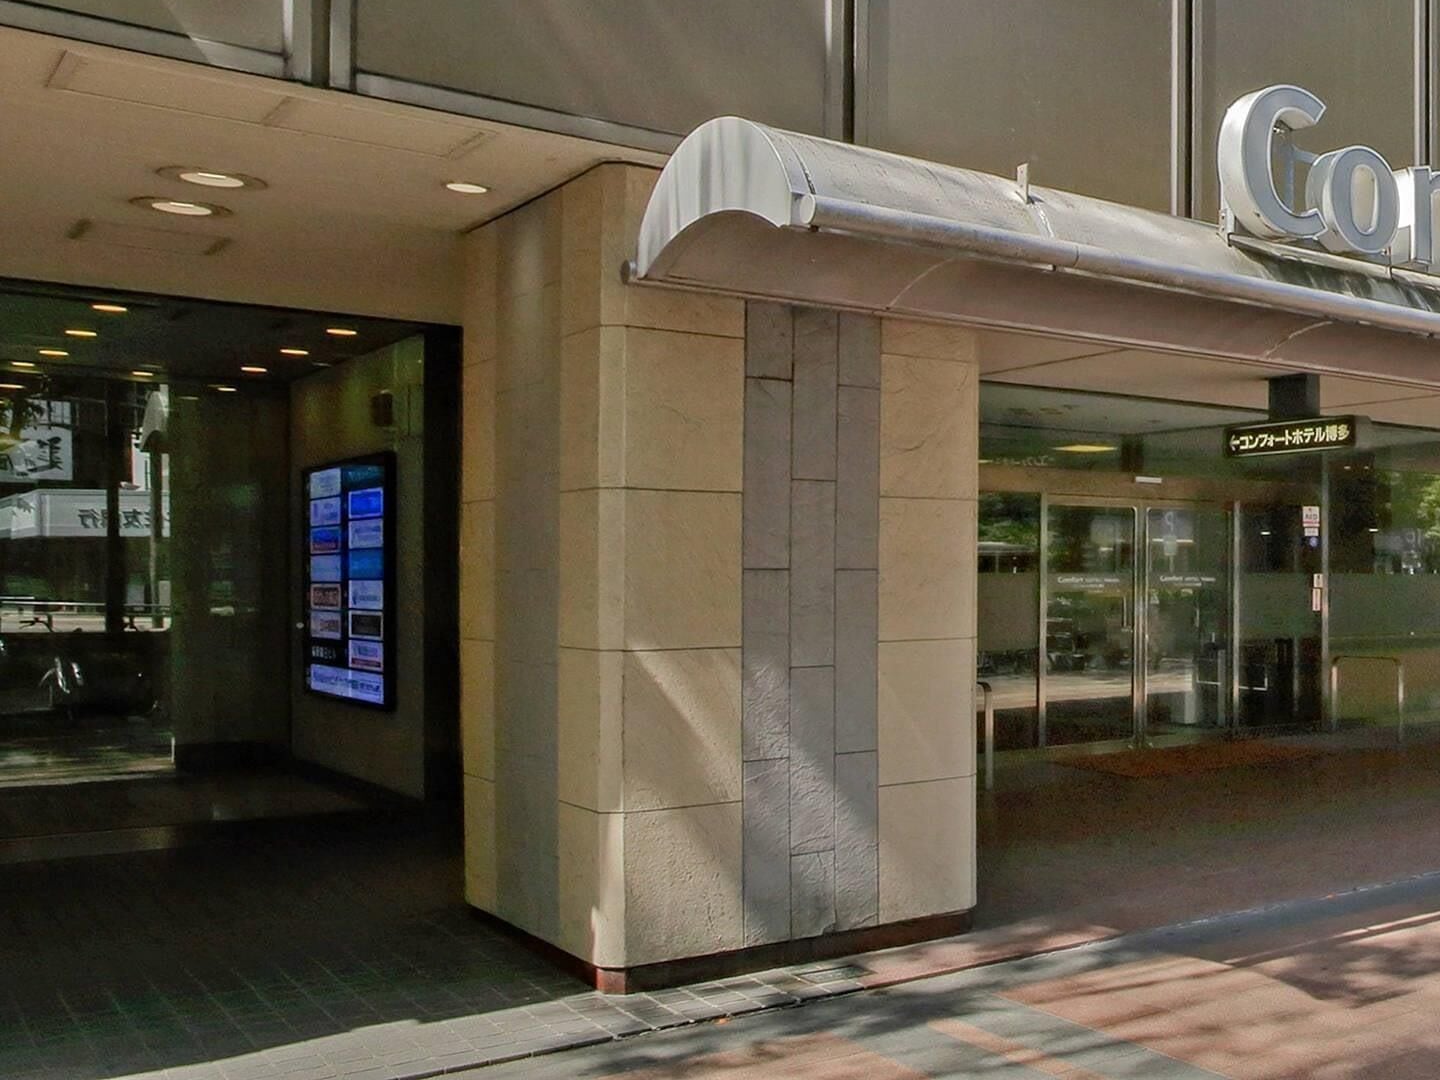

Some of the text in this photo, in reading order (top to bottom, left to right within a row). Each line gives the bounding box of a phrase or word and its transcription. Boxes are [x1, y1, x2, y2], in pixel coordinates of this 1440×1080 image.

[1239, 424, 1350, 450] コンフォートホテル博多
